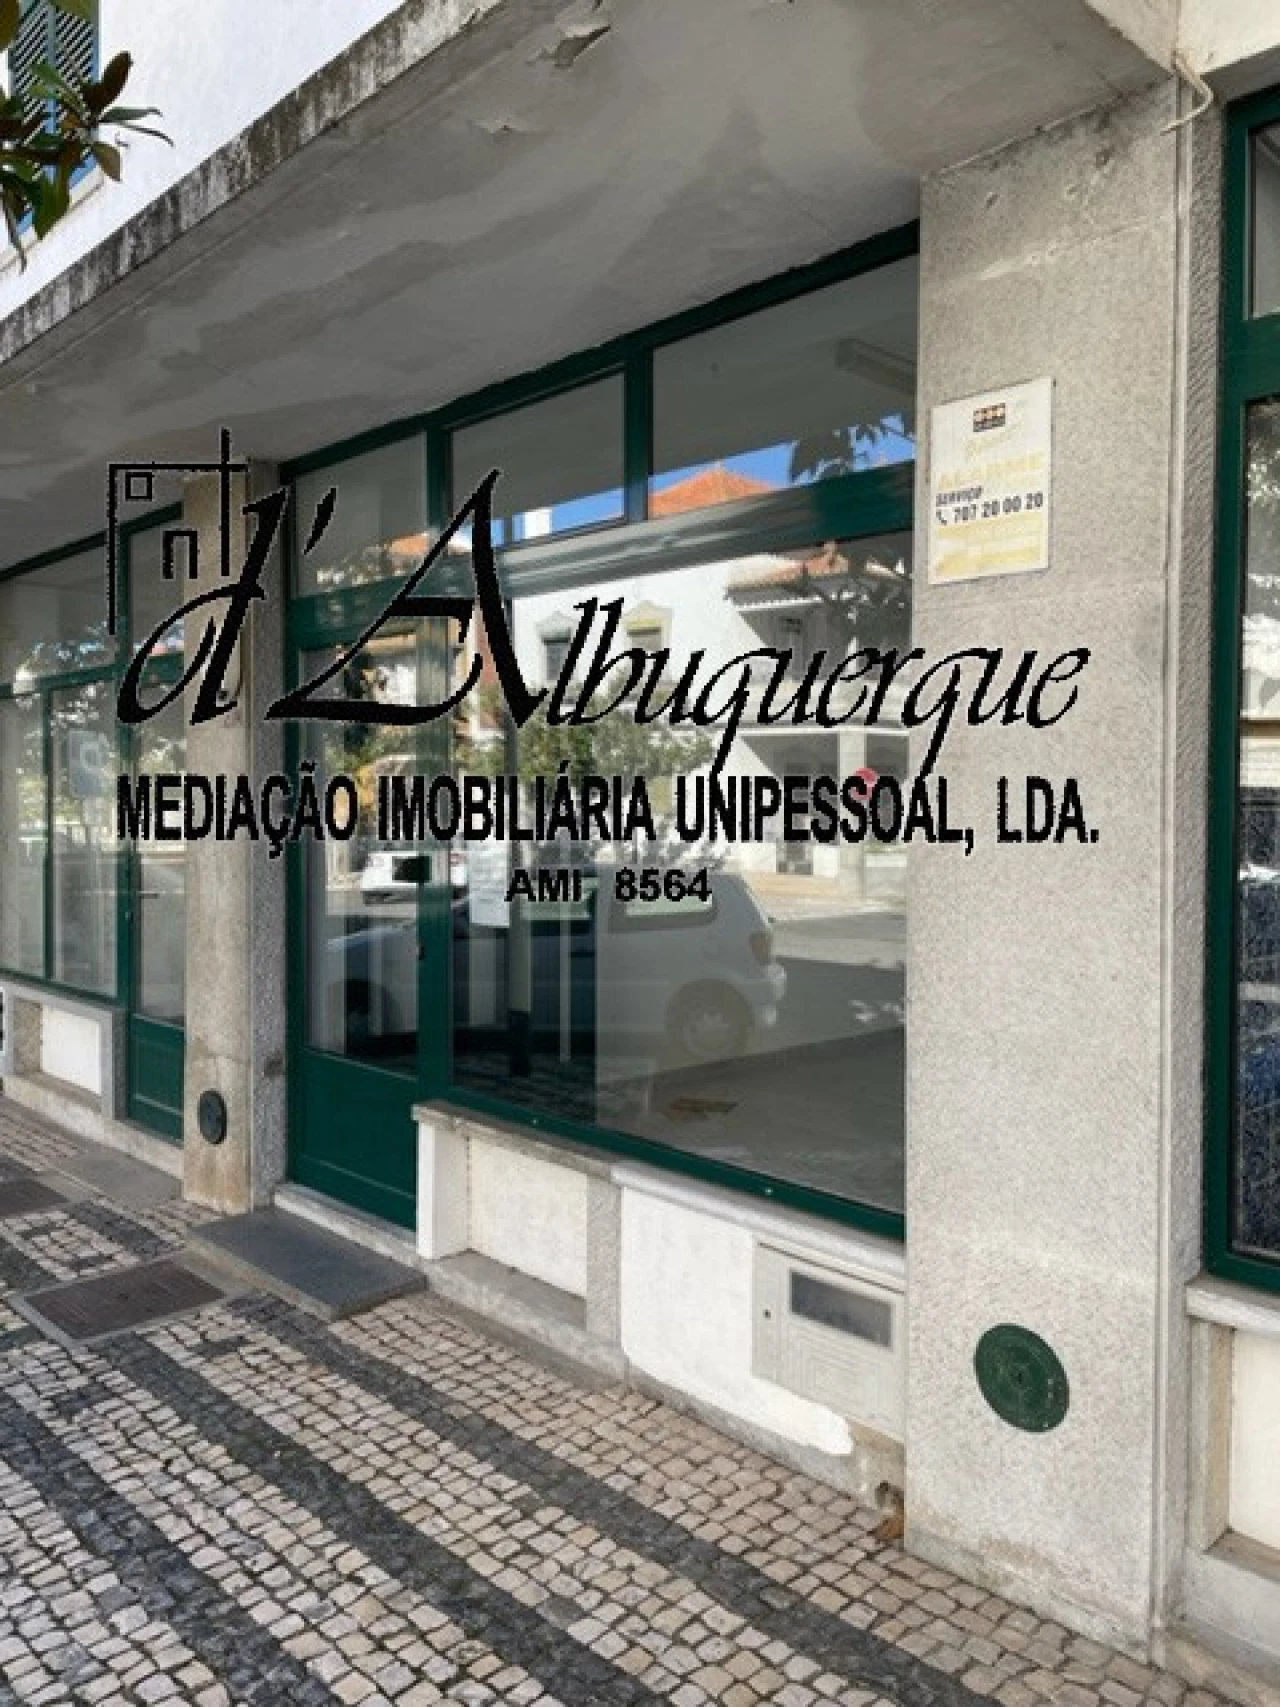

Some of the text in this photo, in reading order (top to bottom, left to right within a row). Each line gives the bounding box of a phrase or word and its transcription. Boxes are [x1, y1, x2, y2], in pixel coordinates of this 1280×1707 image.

[981, 500, 1000, 518] 20
[1003, 495, 1022, 514] 00
[1025, 491, 1044, 510] 20
